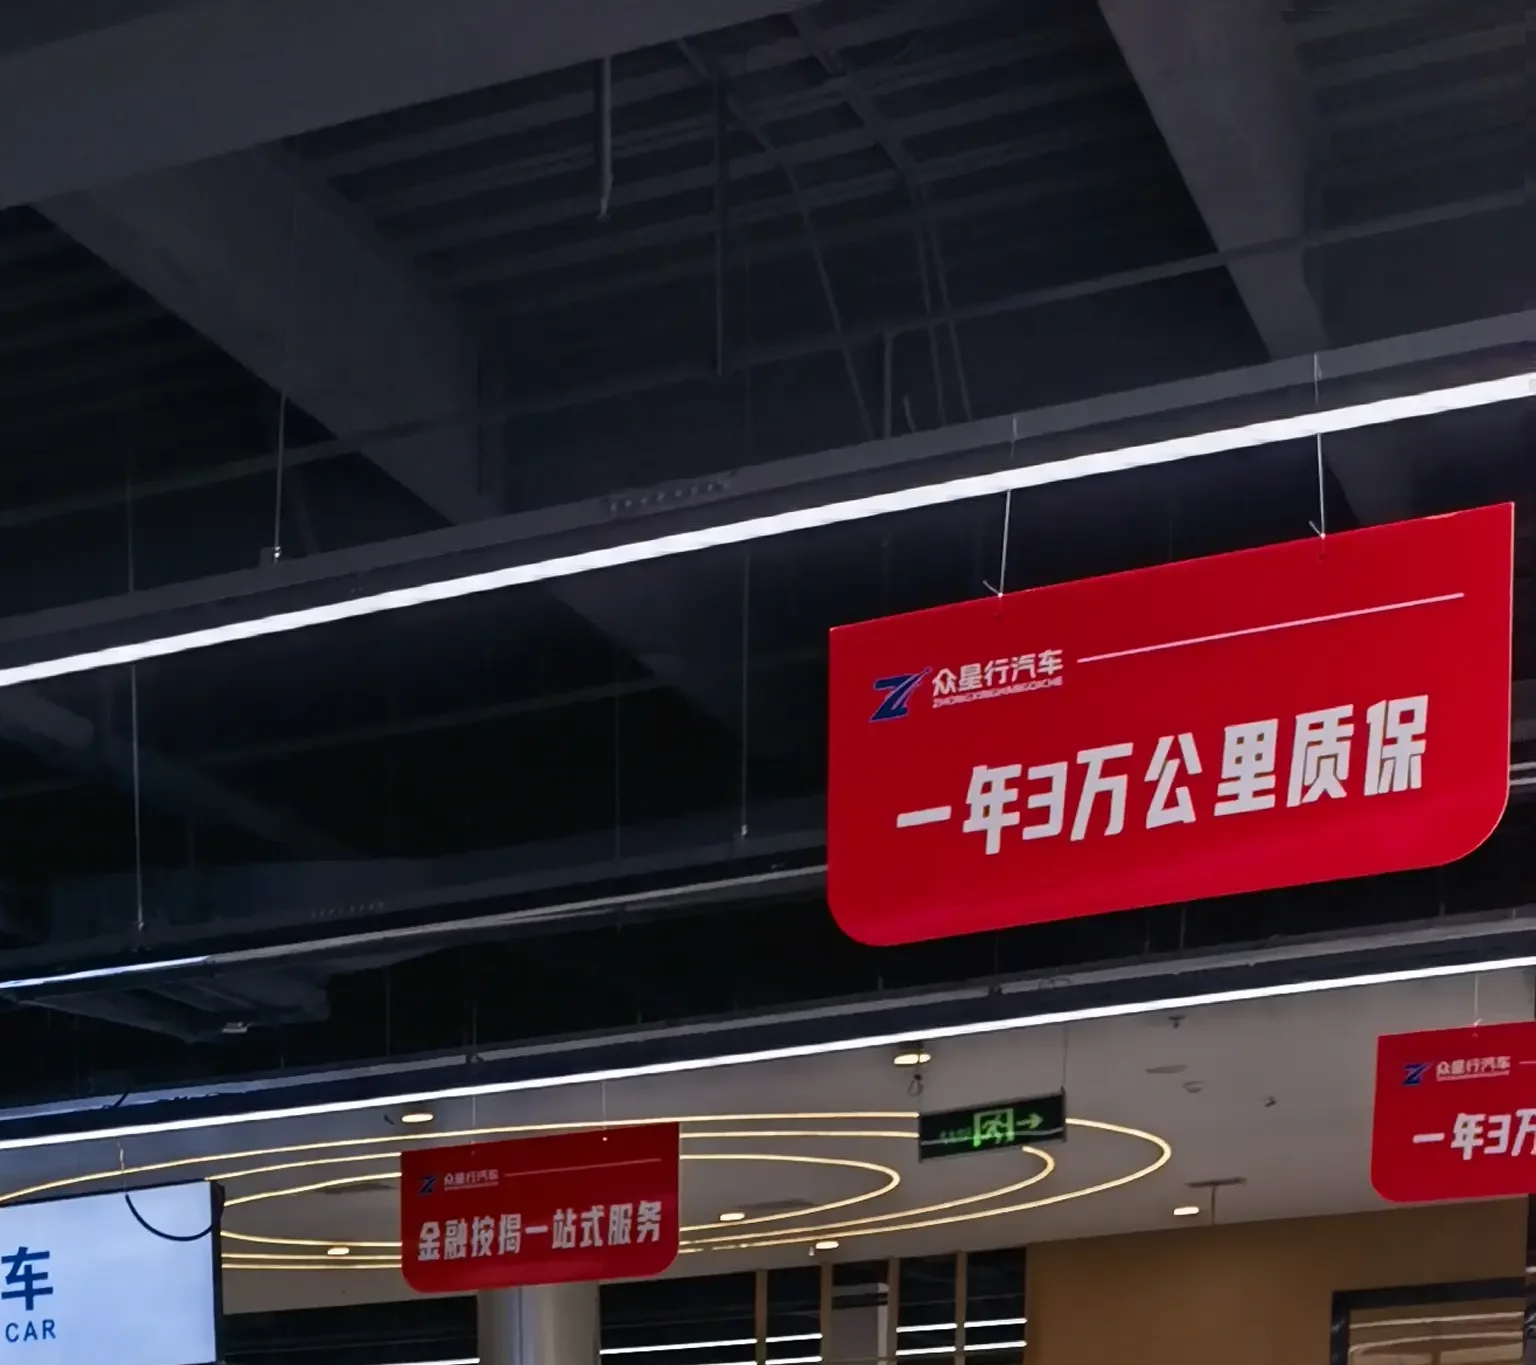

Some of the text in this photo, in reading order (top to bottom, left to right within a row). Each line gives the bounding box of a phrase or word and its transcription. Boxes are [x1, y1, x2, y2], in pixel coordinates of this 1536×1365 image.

[932, 649, 1063, 697] 众星行汽车
[896, 695, 1429, 856] 一年3万公里质保
[417, 1200, 662, 1261] 金融按揭一站式服务
[5, 1319, 56, 1343] CAR
